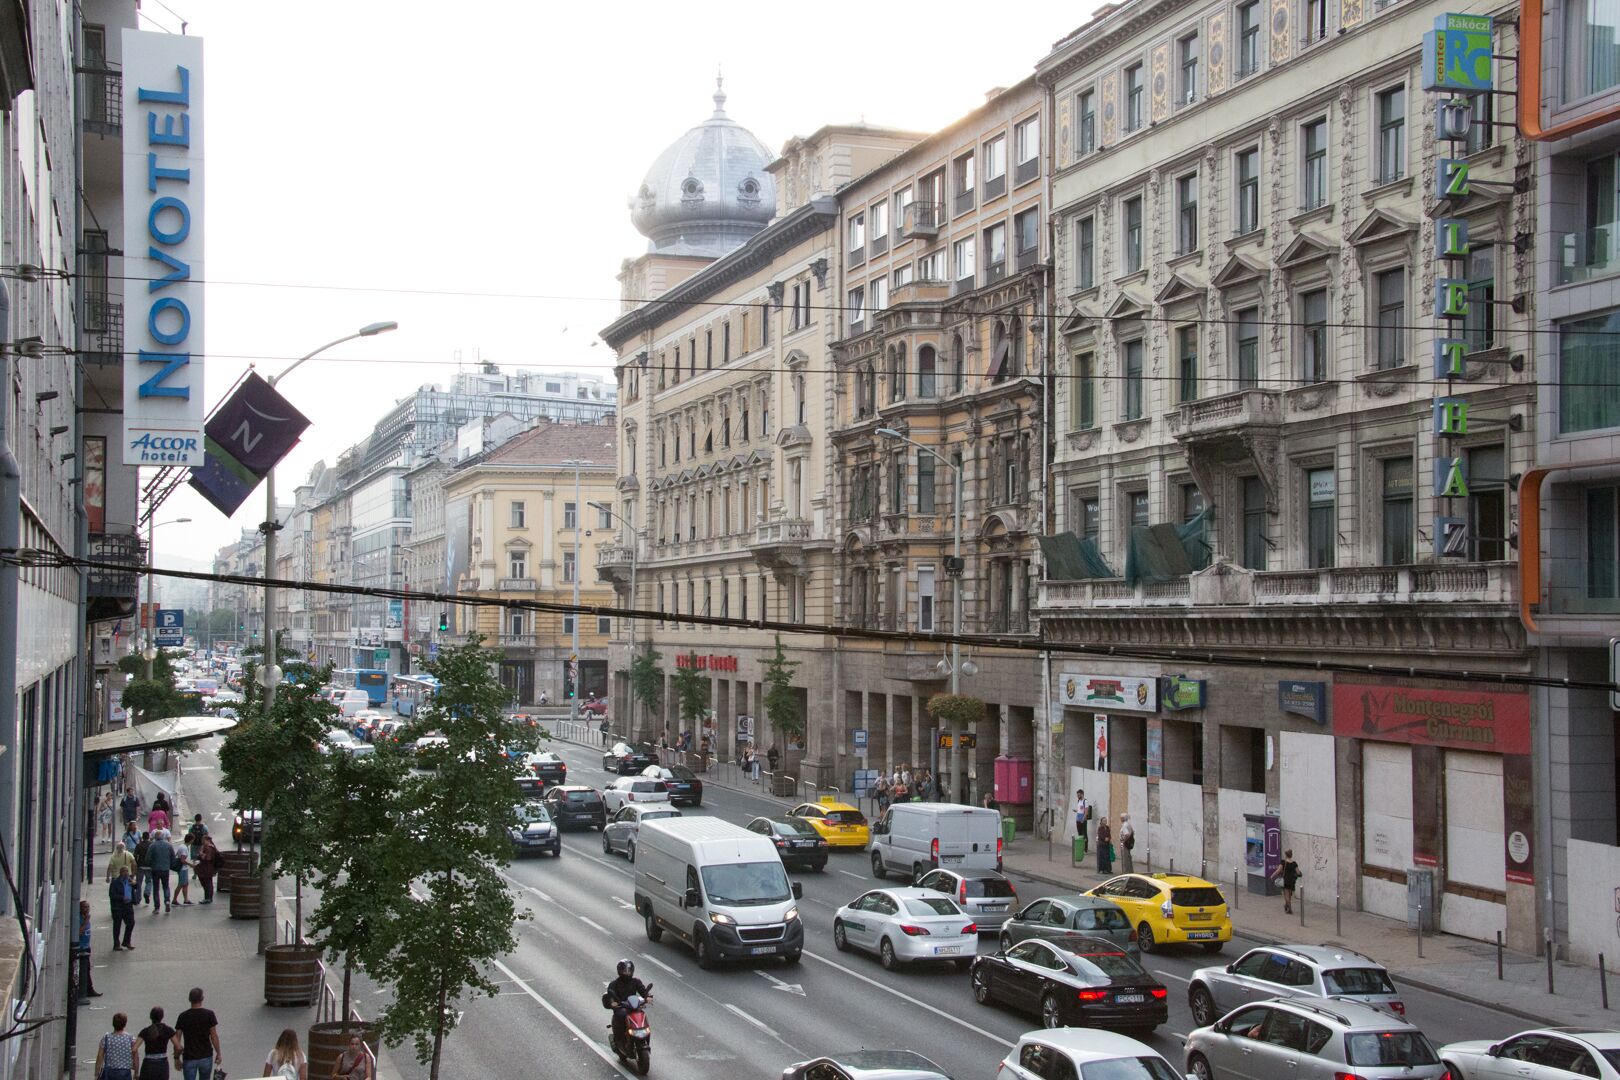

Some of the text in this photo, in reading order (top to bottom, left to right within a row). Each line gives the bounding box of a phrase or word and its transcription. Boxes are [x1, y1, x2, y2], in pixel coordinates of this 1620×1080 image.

[1448, 17, 1490, 30] Rákóczi
[1437, 34, 1445, 82] center
[138, 64, 192, 401] NOVOTEL
[130, 433, 197, 451] ACCOR
[230, 419, 264, 454] N
[141, 450, 188, 462] hotels
[163, 615, 175, 627] P
[1393, 693, 1495, 724] Montenegrói
[1426, 718, 1495, 743] Gurman
